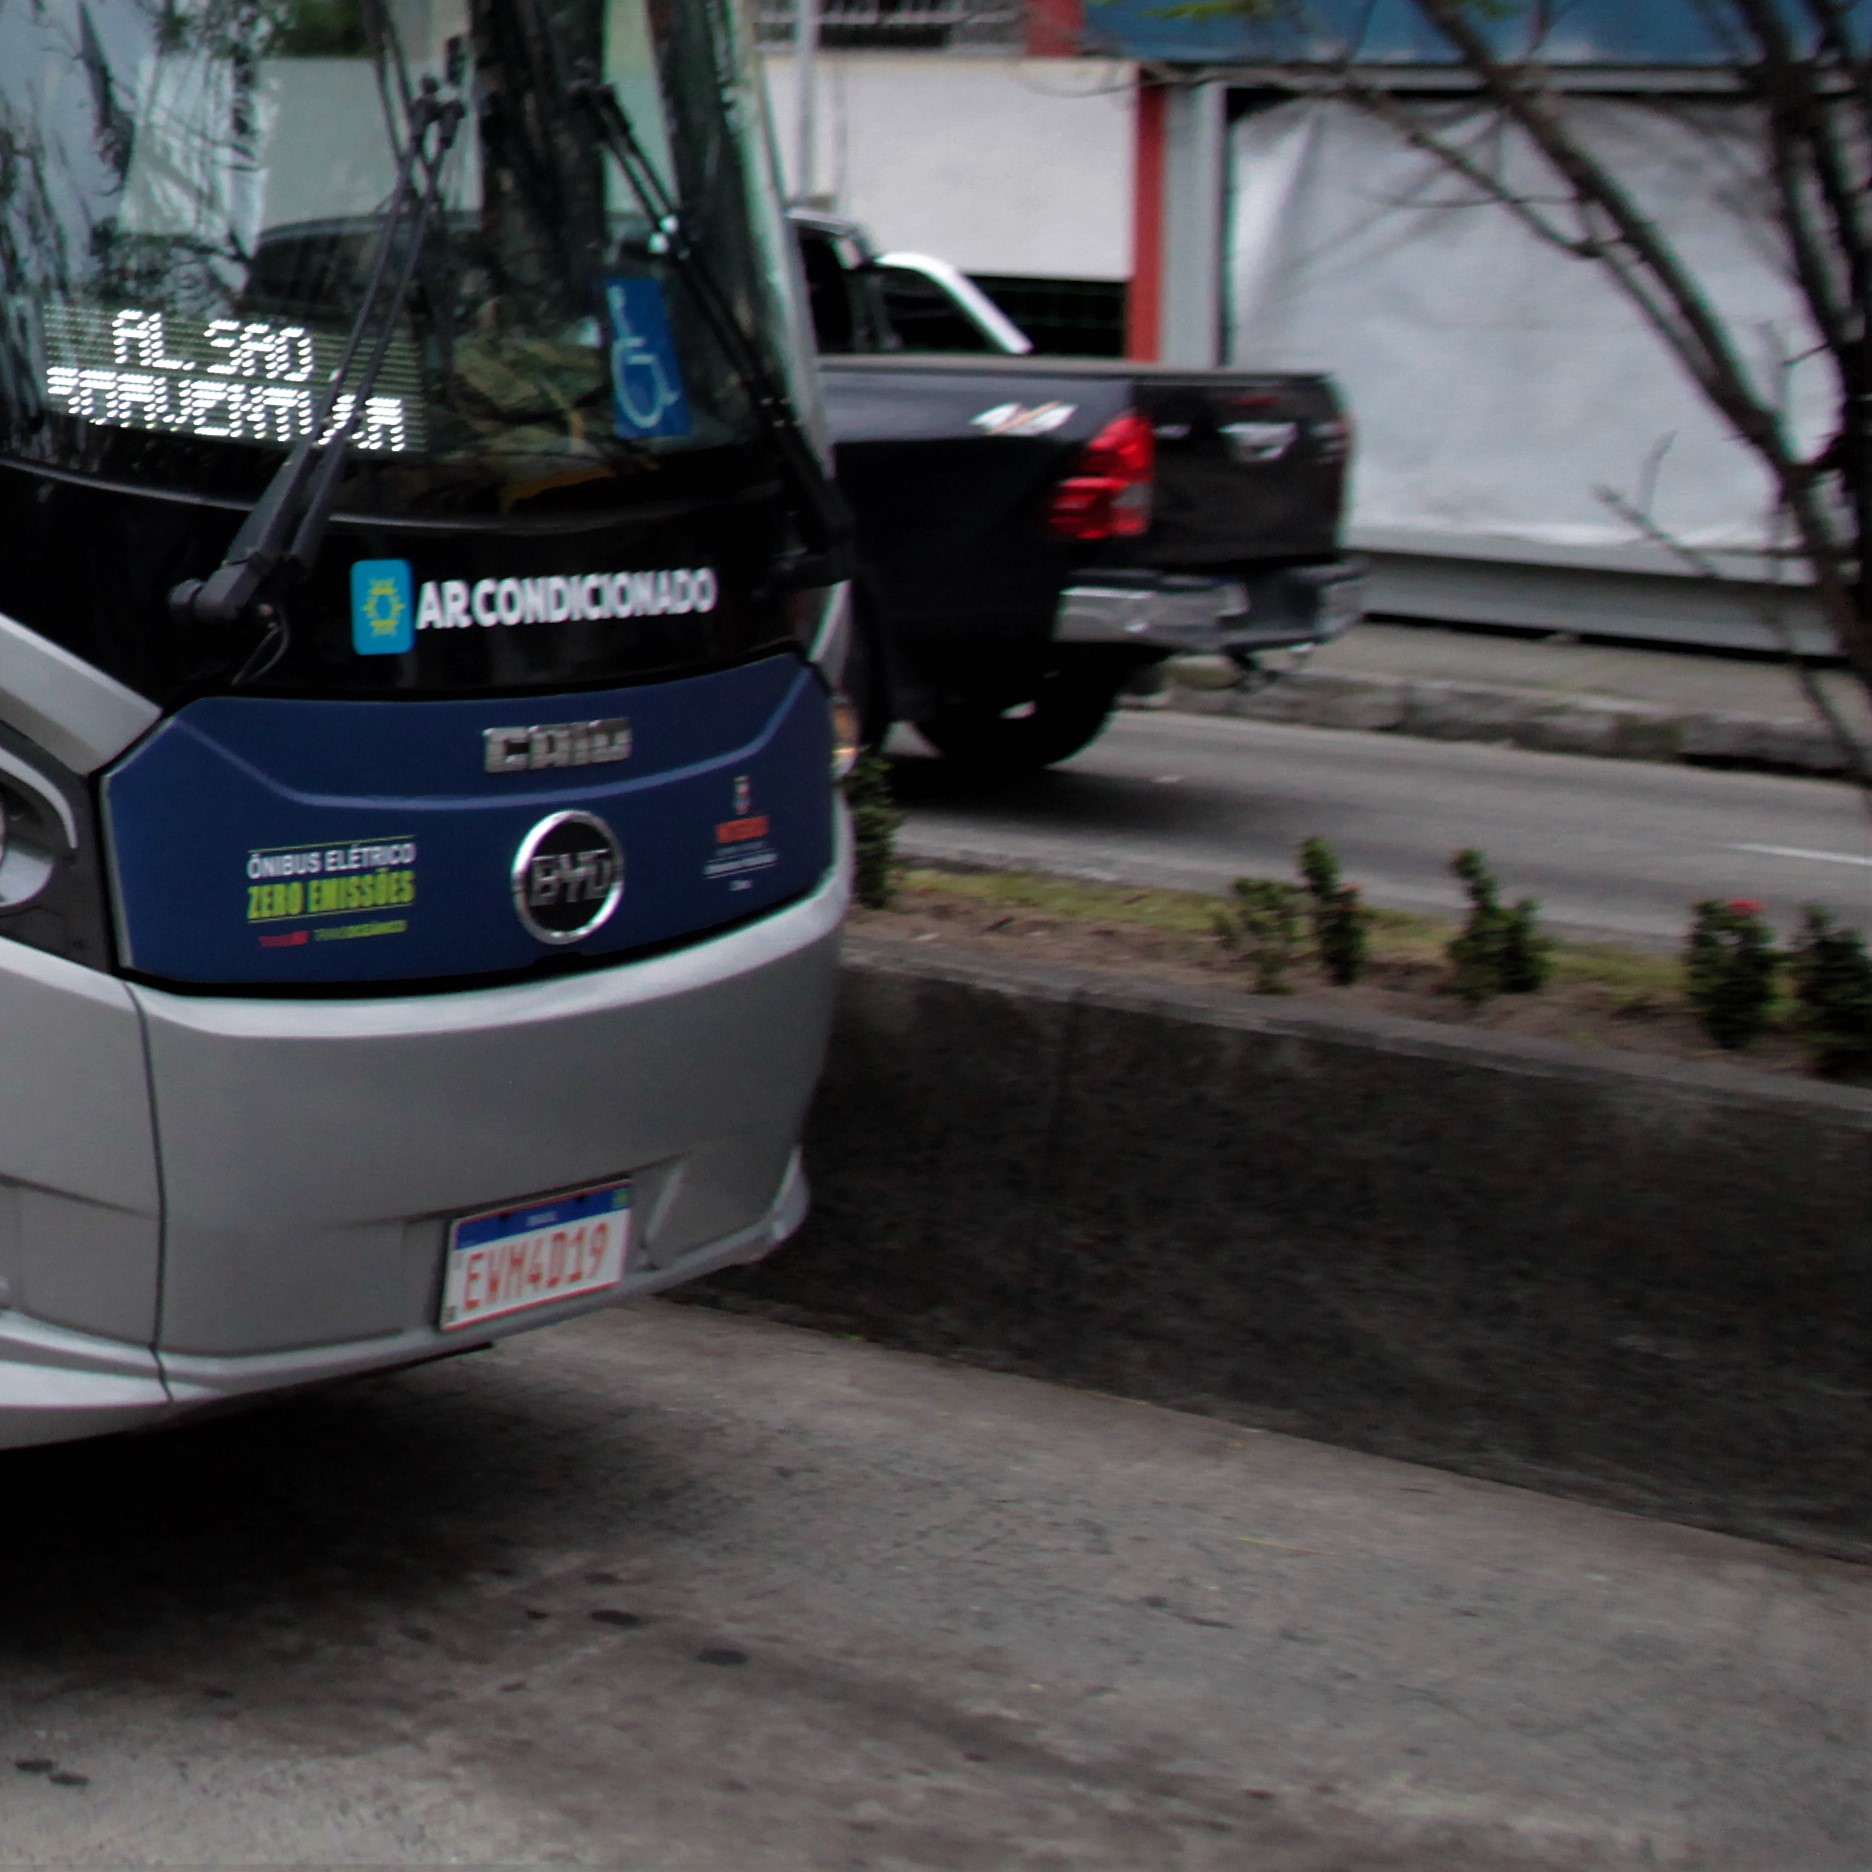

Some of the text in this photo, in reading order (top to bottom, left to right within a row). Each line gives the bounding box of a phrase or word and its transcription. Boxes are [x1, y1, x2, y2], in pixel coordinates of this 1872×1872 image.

[415, 567, 717, 631] AR CONDICIONADO
[246, 843, 417, 880] ÔNIBUS ELÉTRICO
[529, 848, 612, 907] BYD
[247, 867, 416, 919] ZERO EMISSÕES
